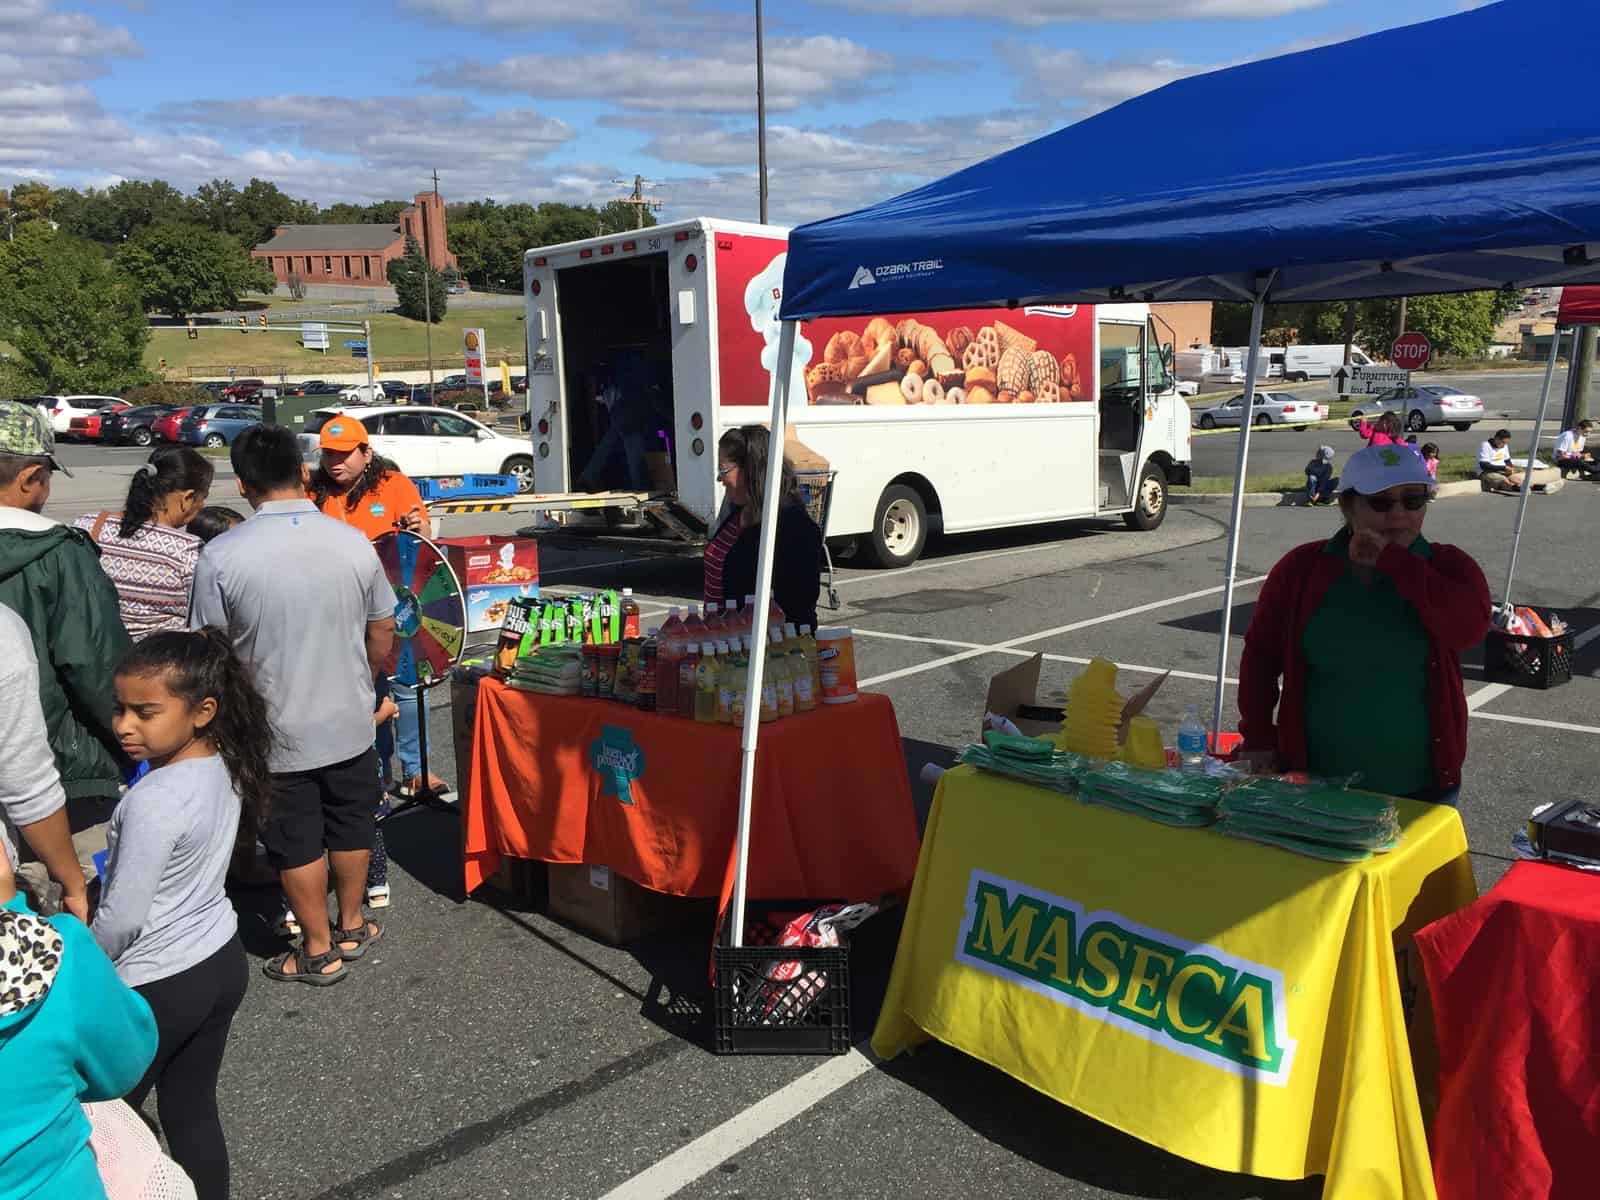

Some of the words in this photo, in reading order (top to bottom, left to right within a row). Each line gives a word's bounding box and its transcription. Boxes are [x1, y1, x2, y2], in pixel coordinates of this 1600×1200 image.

[875, 263, 911, 277] OZARK
[912, 259, 944, 271] TRAIL
[1394, 344, 1428, 359] STOP
[965, 881, 1283, 1073] MASECA
